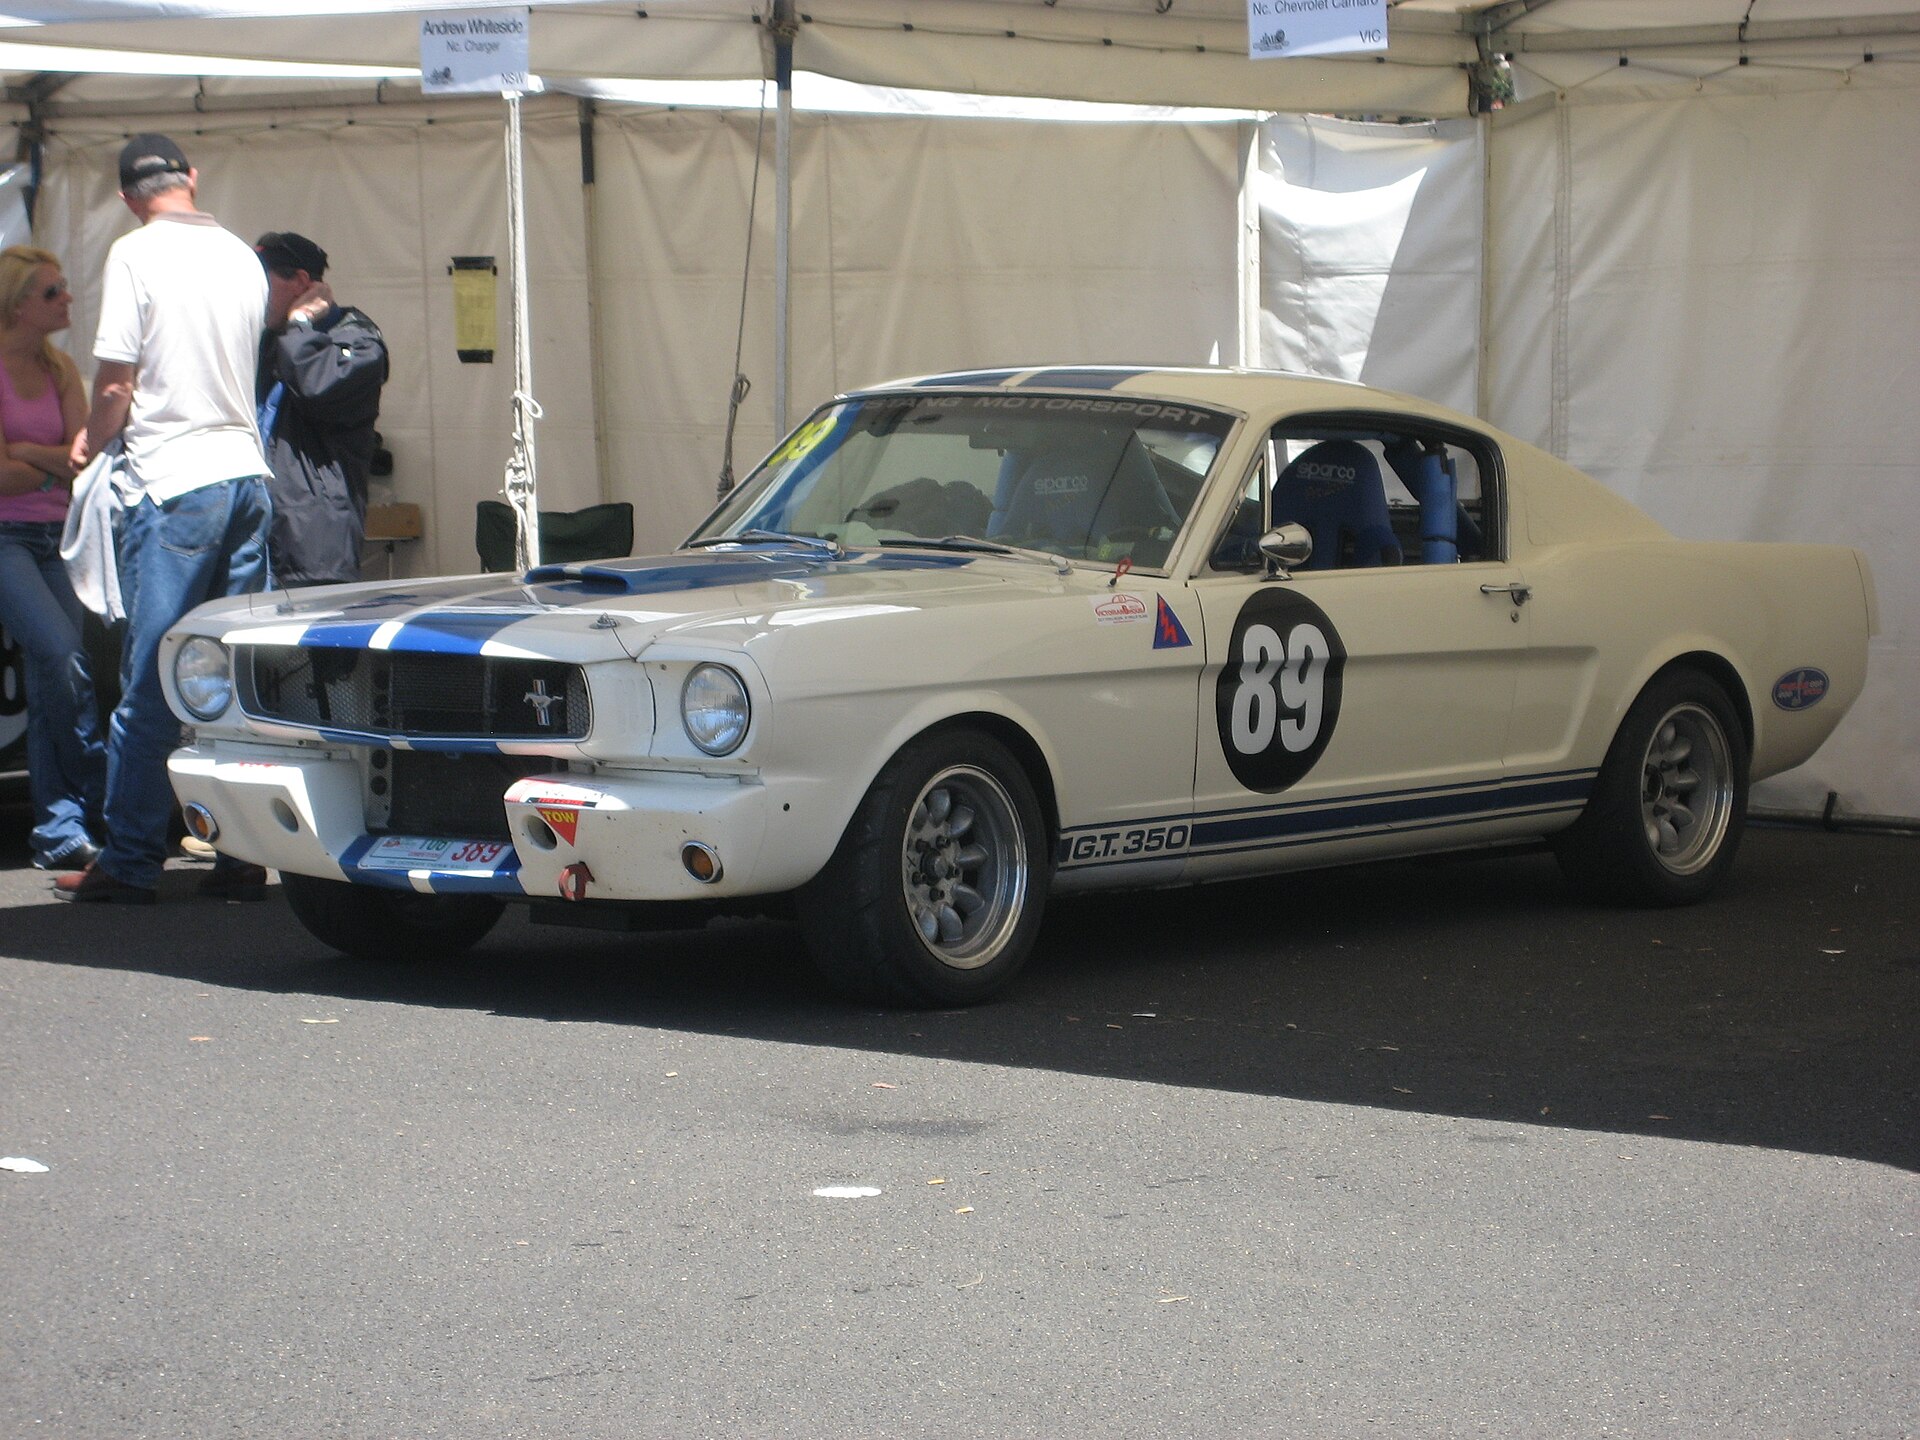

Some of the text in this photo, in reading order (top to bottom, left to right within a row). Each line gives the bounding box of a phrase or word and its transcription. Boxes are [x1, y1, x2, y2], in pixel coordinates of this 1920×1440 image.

[1275, 0, 1328, 13] Chevrolet
[423, 18, 523, 36] Andrew Whiteside
[1359, 29, 1382, 43] VIC
[465, 39, 500, 54] Charger
[501, 72, 525, 85] NSW
[847, 396, 1211, 426] USTANG MOTORSPORT
[1297, 463, 1356, 480] sparco
[1232, 623, 1330, 755] 89
[542, 809, 576, 824] TOW
[1122, 825, 1189, 854] 350
[451, 840, 506, 864] 389
